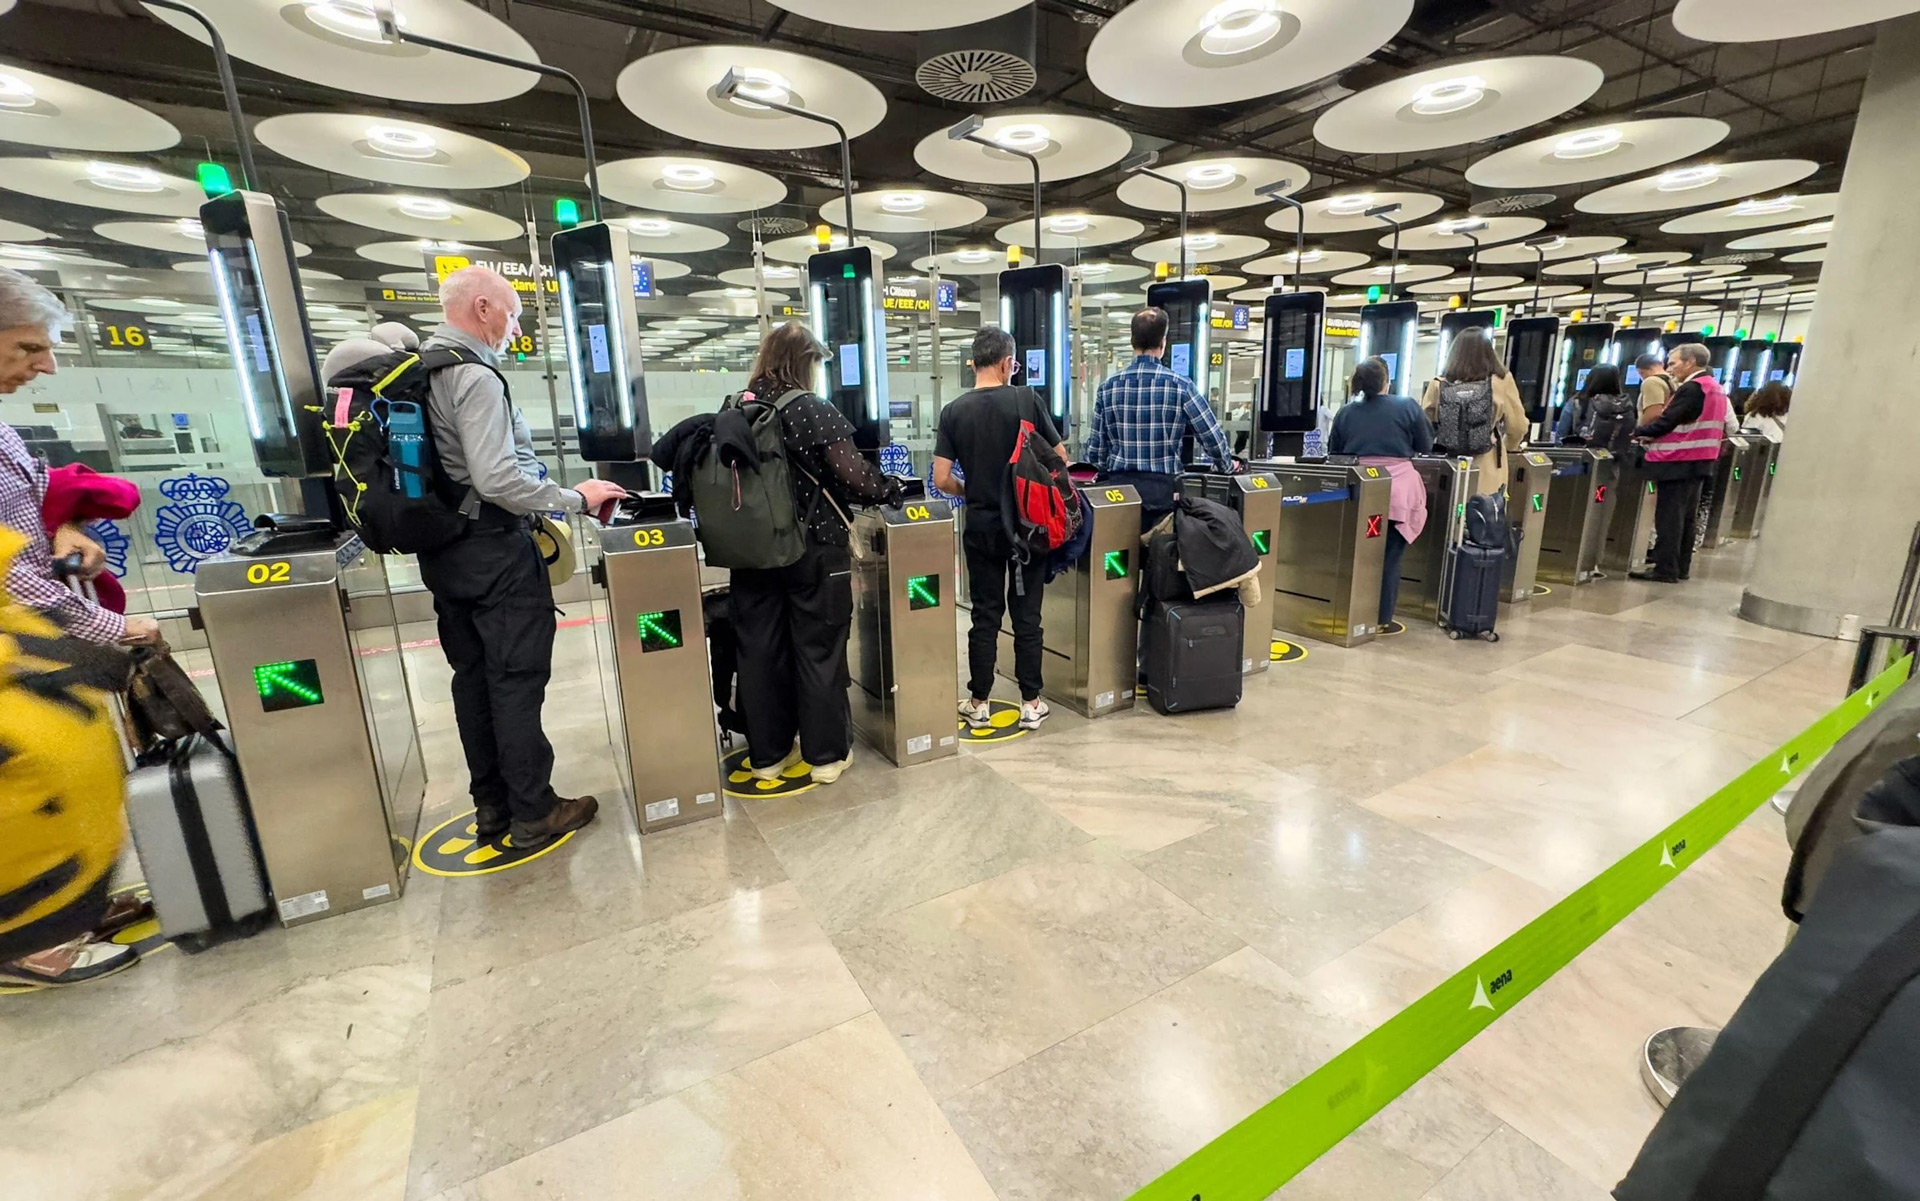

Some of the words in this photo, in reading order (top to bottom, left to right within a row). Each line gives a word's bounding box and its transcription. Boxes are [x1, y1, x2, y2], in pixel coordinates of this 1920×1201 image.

[106, 325, 145, 346] 16
[510, 335, 533, 352] 18
[1211, 353, 1223, 364] 23
[1252, 477, 1268, 489] 06
[1105, 489, 1125, 502] 05
[906, 505, 930, 520] 04
[634, 528, 665, 547] 03
[247, 562, 290, 584] 02
[1671, 839, 1686, 857] aena
[1489, 968, 1513, 995] aena
